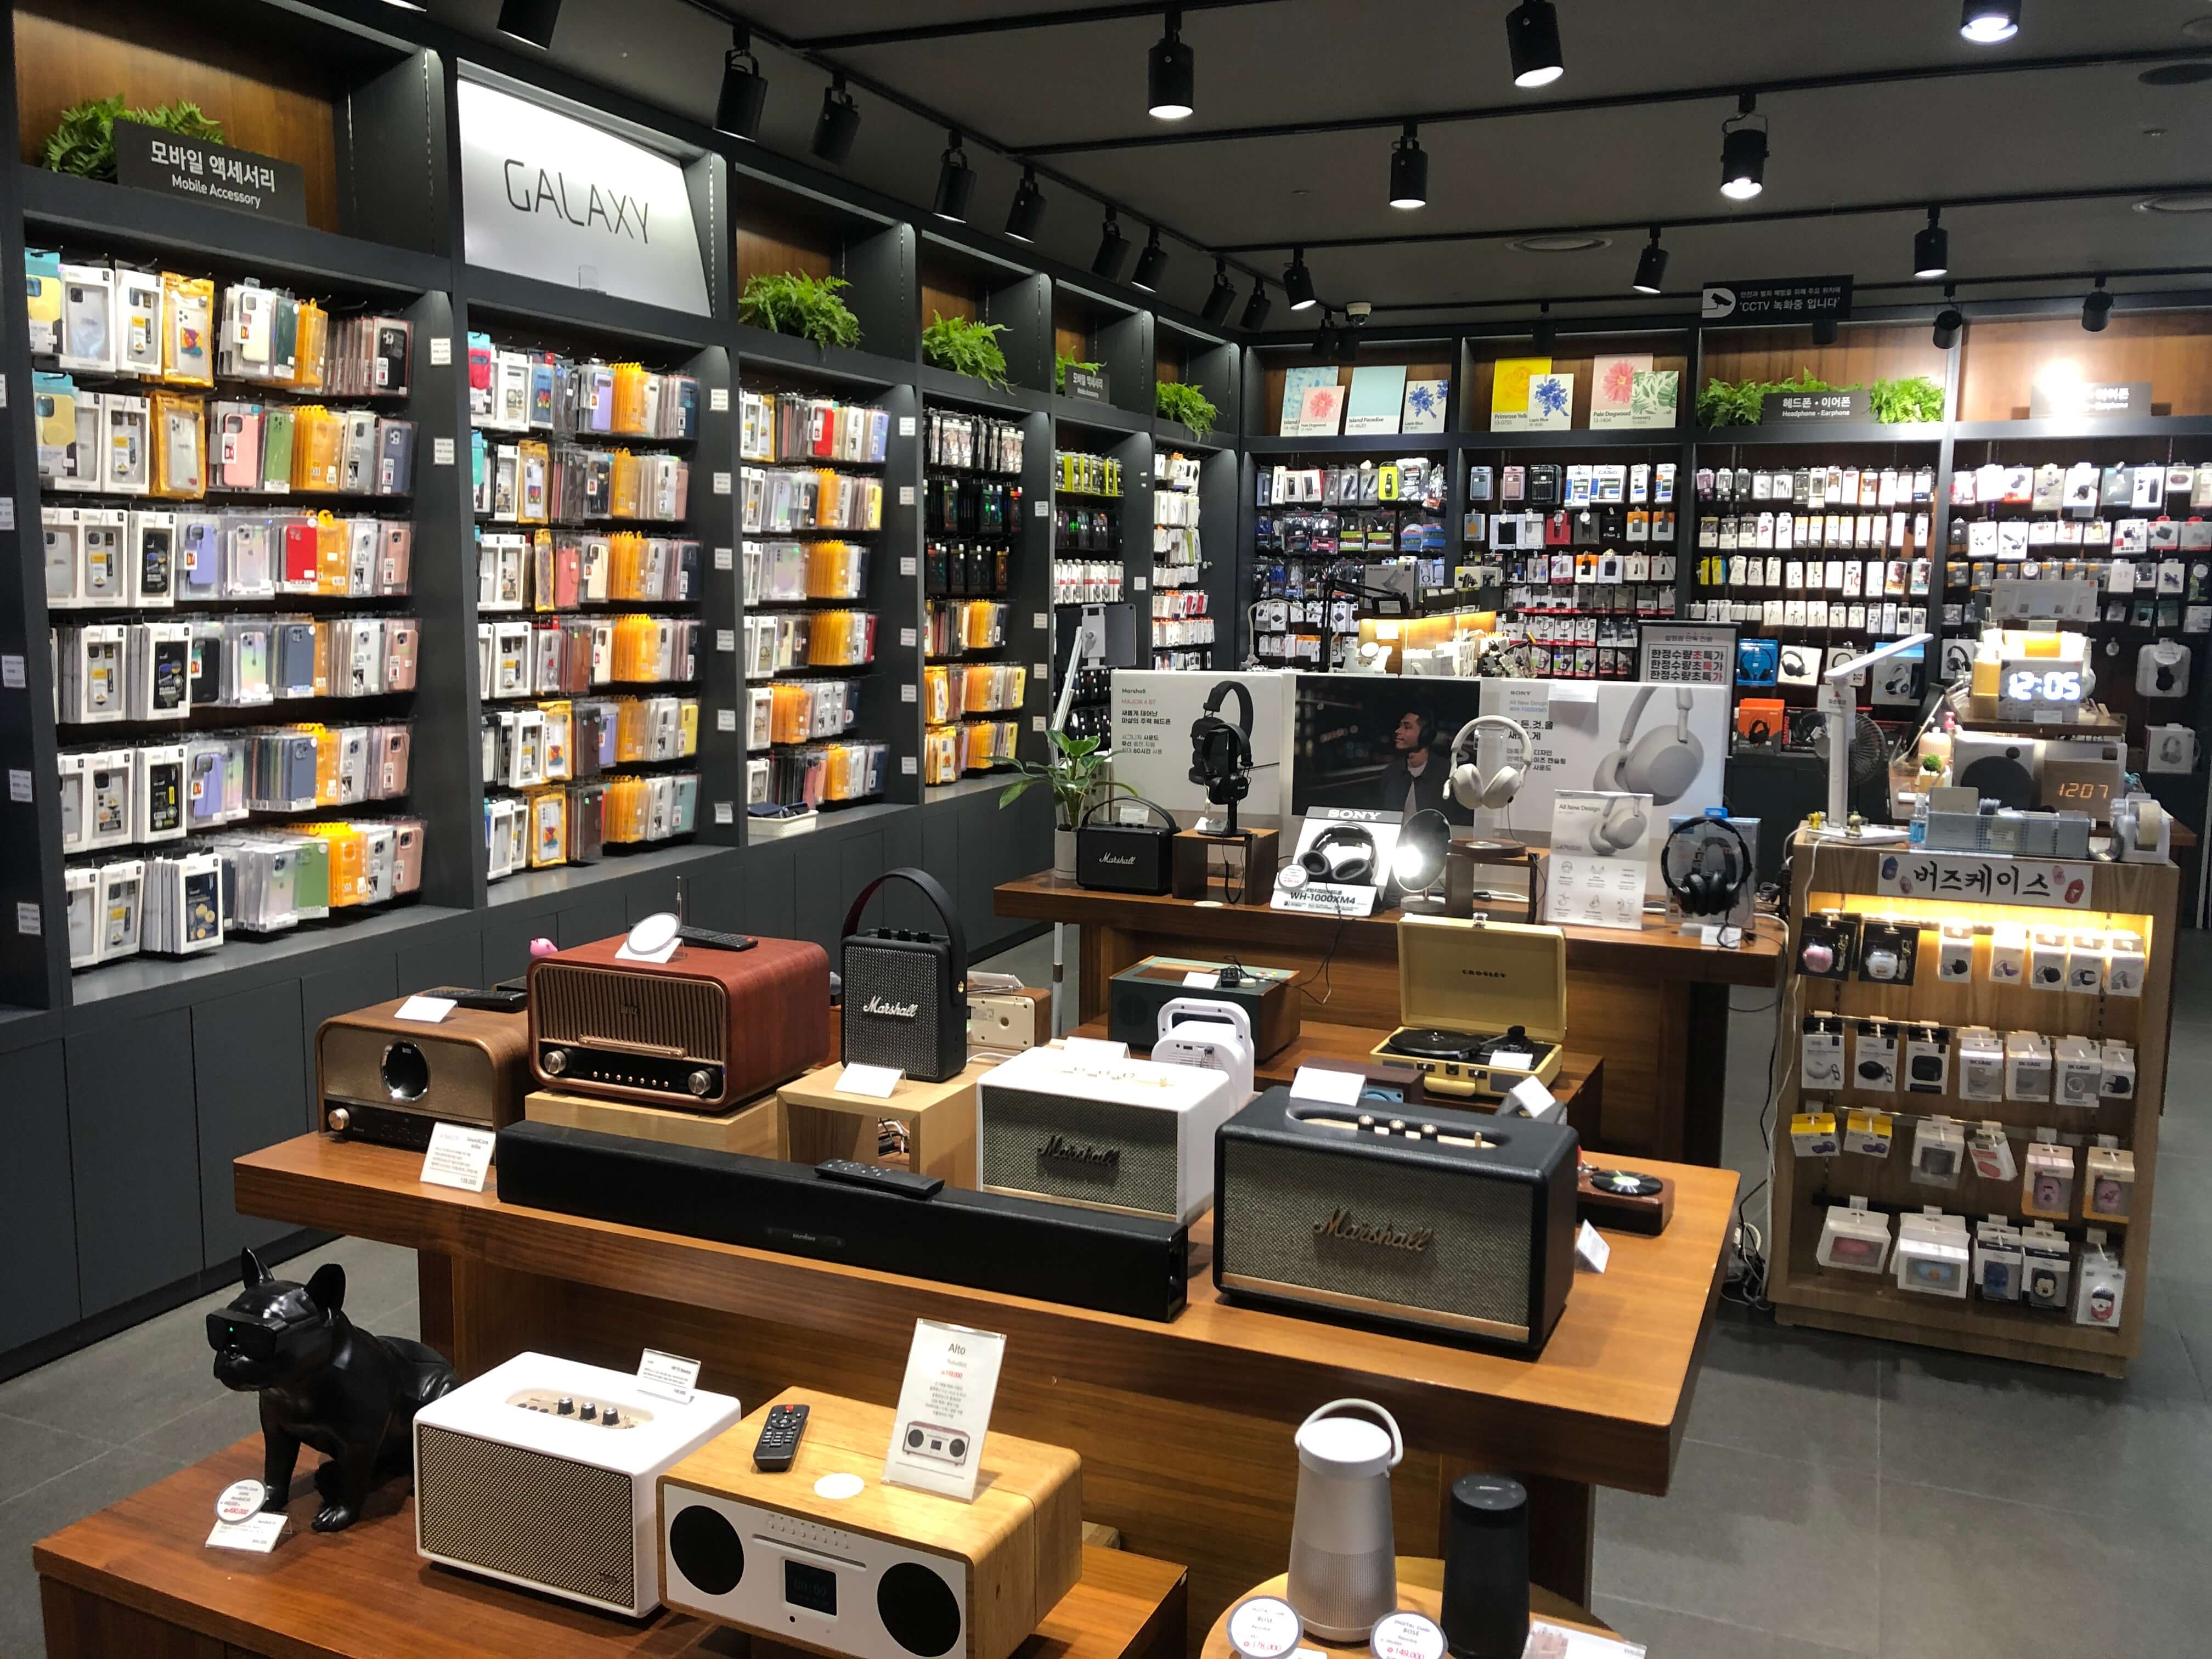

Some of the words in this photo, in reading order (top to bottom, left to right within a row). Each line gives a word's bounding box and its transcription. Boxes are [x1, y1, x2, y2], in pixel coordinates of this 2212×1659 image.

[151, 140, 204, 176] 모바일
[209, 155, 275, 193] 액세서리
[172, 174, 208, 195] Mobile
[210, 183, 261, 210] Accessory
[504, 159, 649, 245] GALAXY
[1773, 299, 1803, 311] 녹화중
[1783, 397, 1812, 408] 헤드폰
[1821, 396, 1851, 408] 이어폰
[1651, 649, 1724, 661] 한정수량초특가
[1650, 659, 1723, 671] 한정수량초특가
[1650, 670, 1723, 682] 한정수량초특가
[2008, 672, 2080, 701] 12:05
[1328, 809, 1381, 820] SONY
[1099, 852, 1136, 865] Marshall
[1914, 860, 2051, 898] 버즈케이스
[1290, 891, 1356, 905] WH-1000XM4
[1462, 969, 1506, 978] CROSLEY
[863, 996, 918, 1017] Marshall
[1037, 1135, 1120, 1164] Marshall
[1314, 1207, 1434, 1251] Marshall
[948, 1342, 966, 1356] Alto
[1403, 1628, 1419, 1636] BOSE
[1253, 1641, 1282, 1652] 178,000
